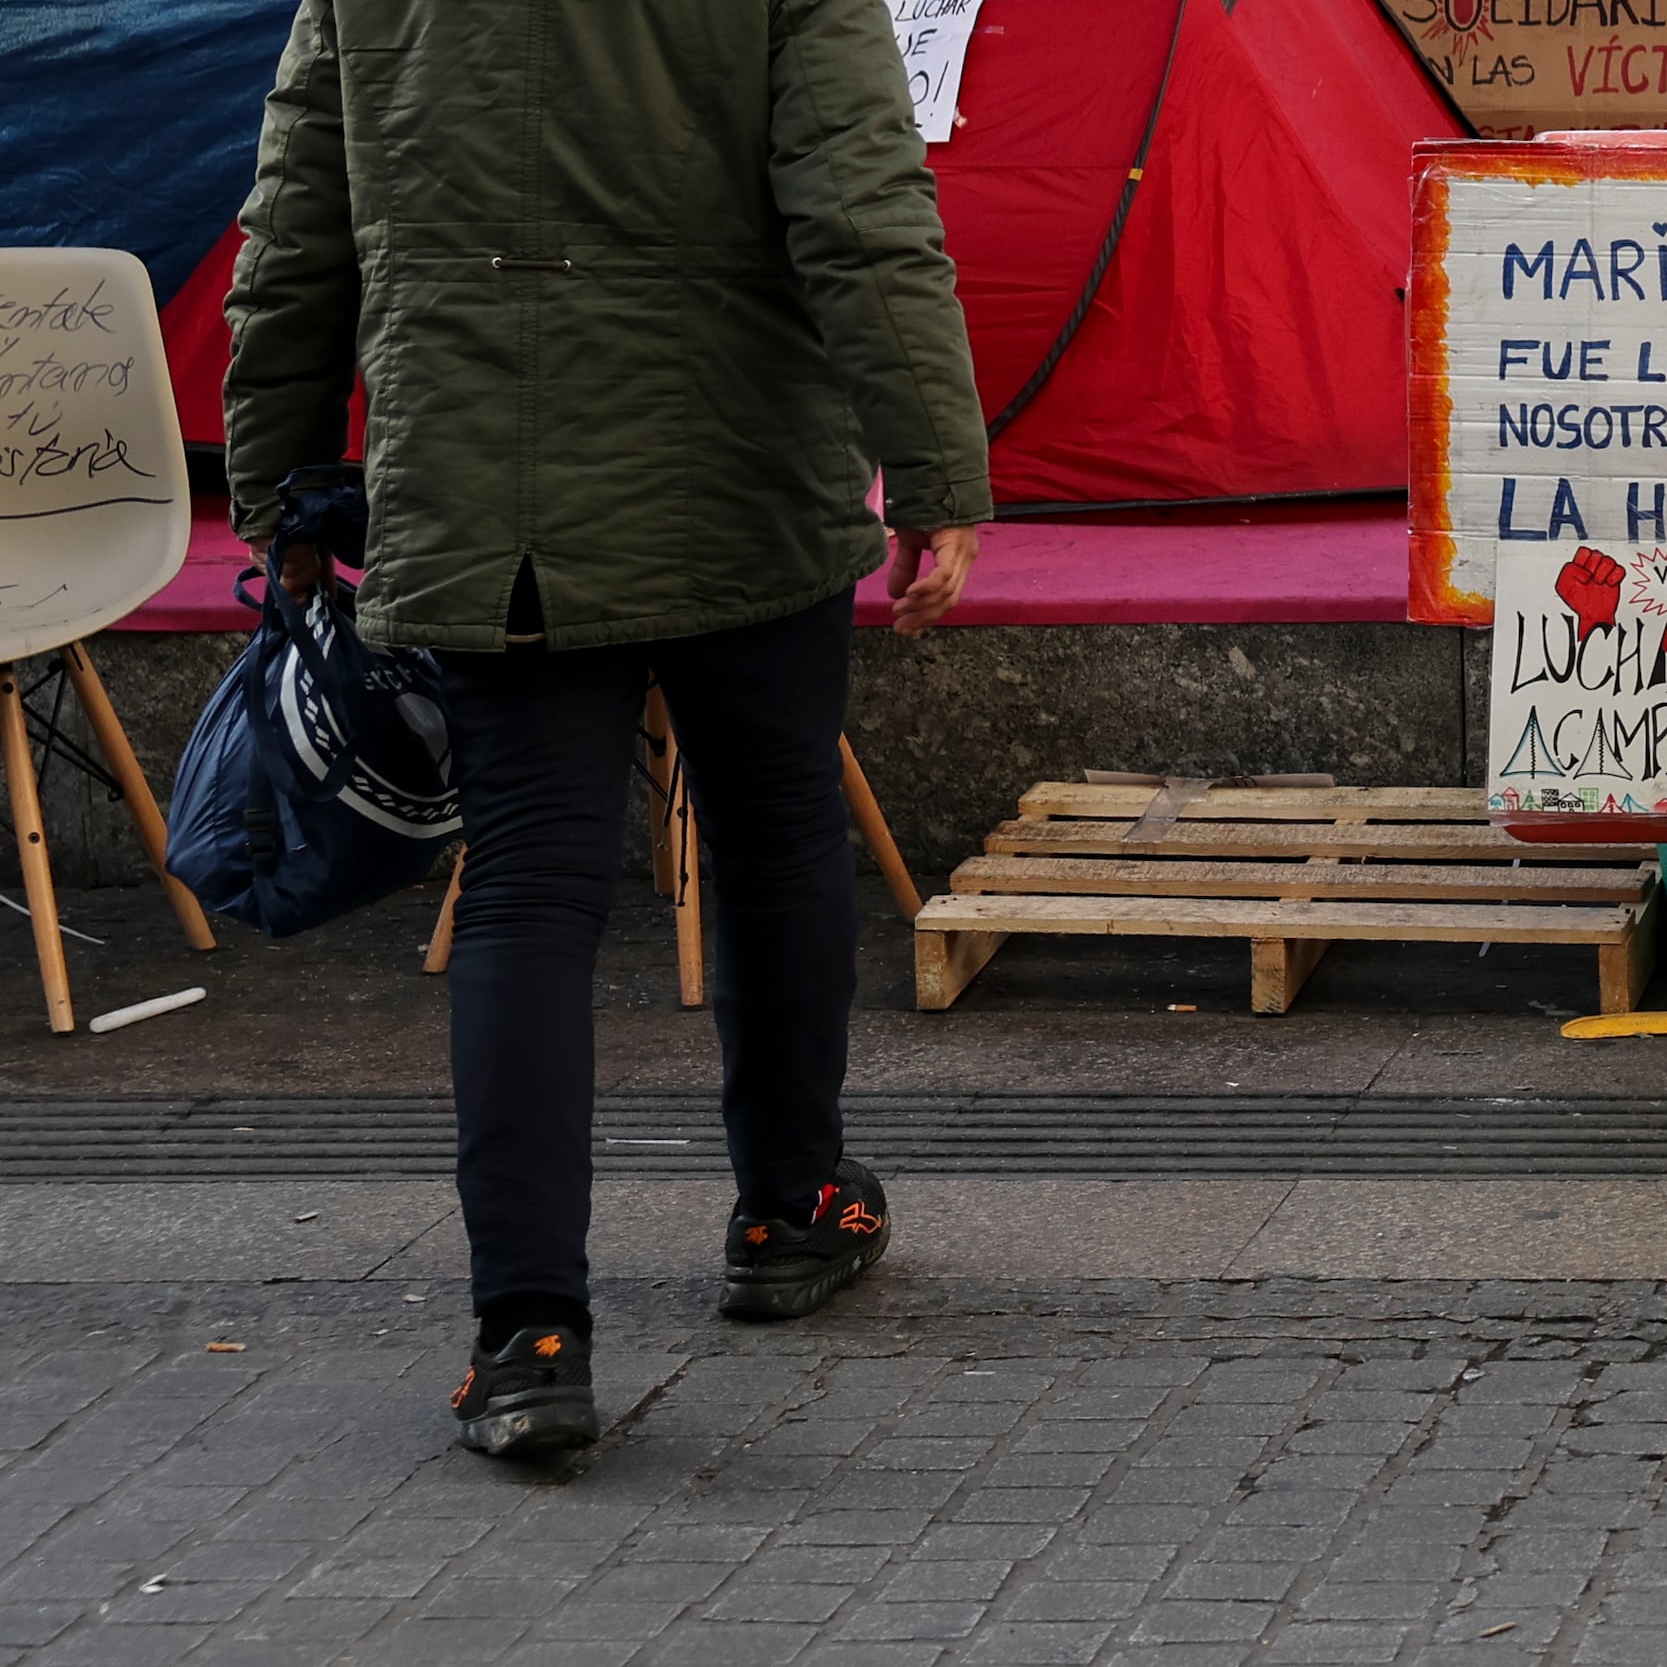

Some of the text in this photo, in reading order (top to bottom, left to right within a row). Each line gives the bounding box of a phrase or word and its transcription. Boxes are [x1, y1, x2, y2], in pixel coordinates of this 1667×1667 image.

[1472, 53, 1536, 88] LAS
[1500, 339, 1610, 381] FUE
[1500, 478, 1588, 541] LA
